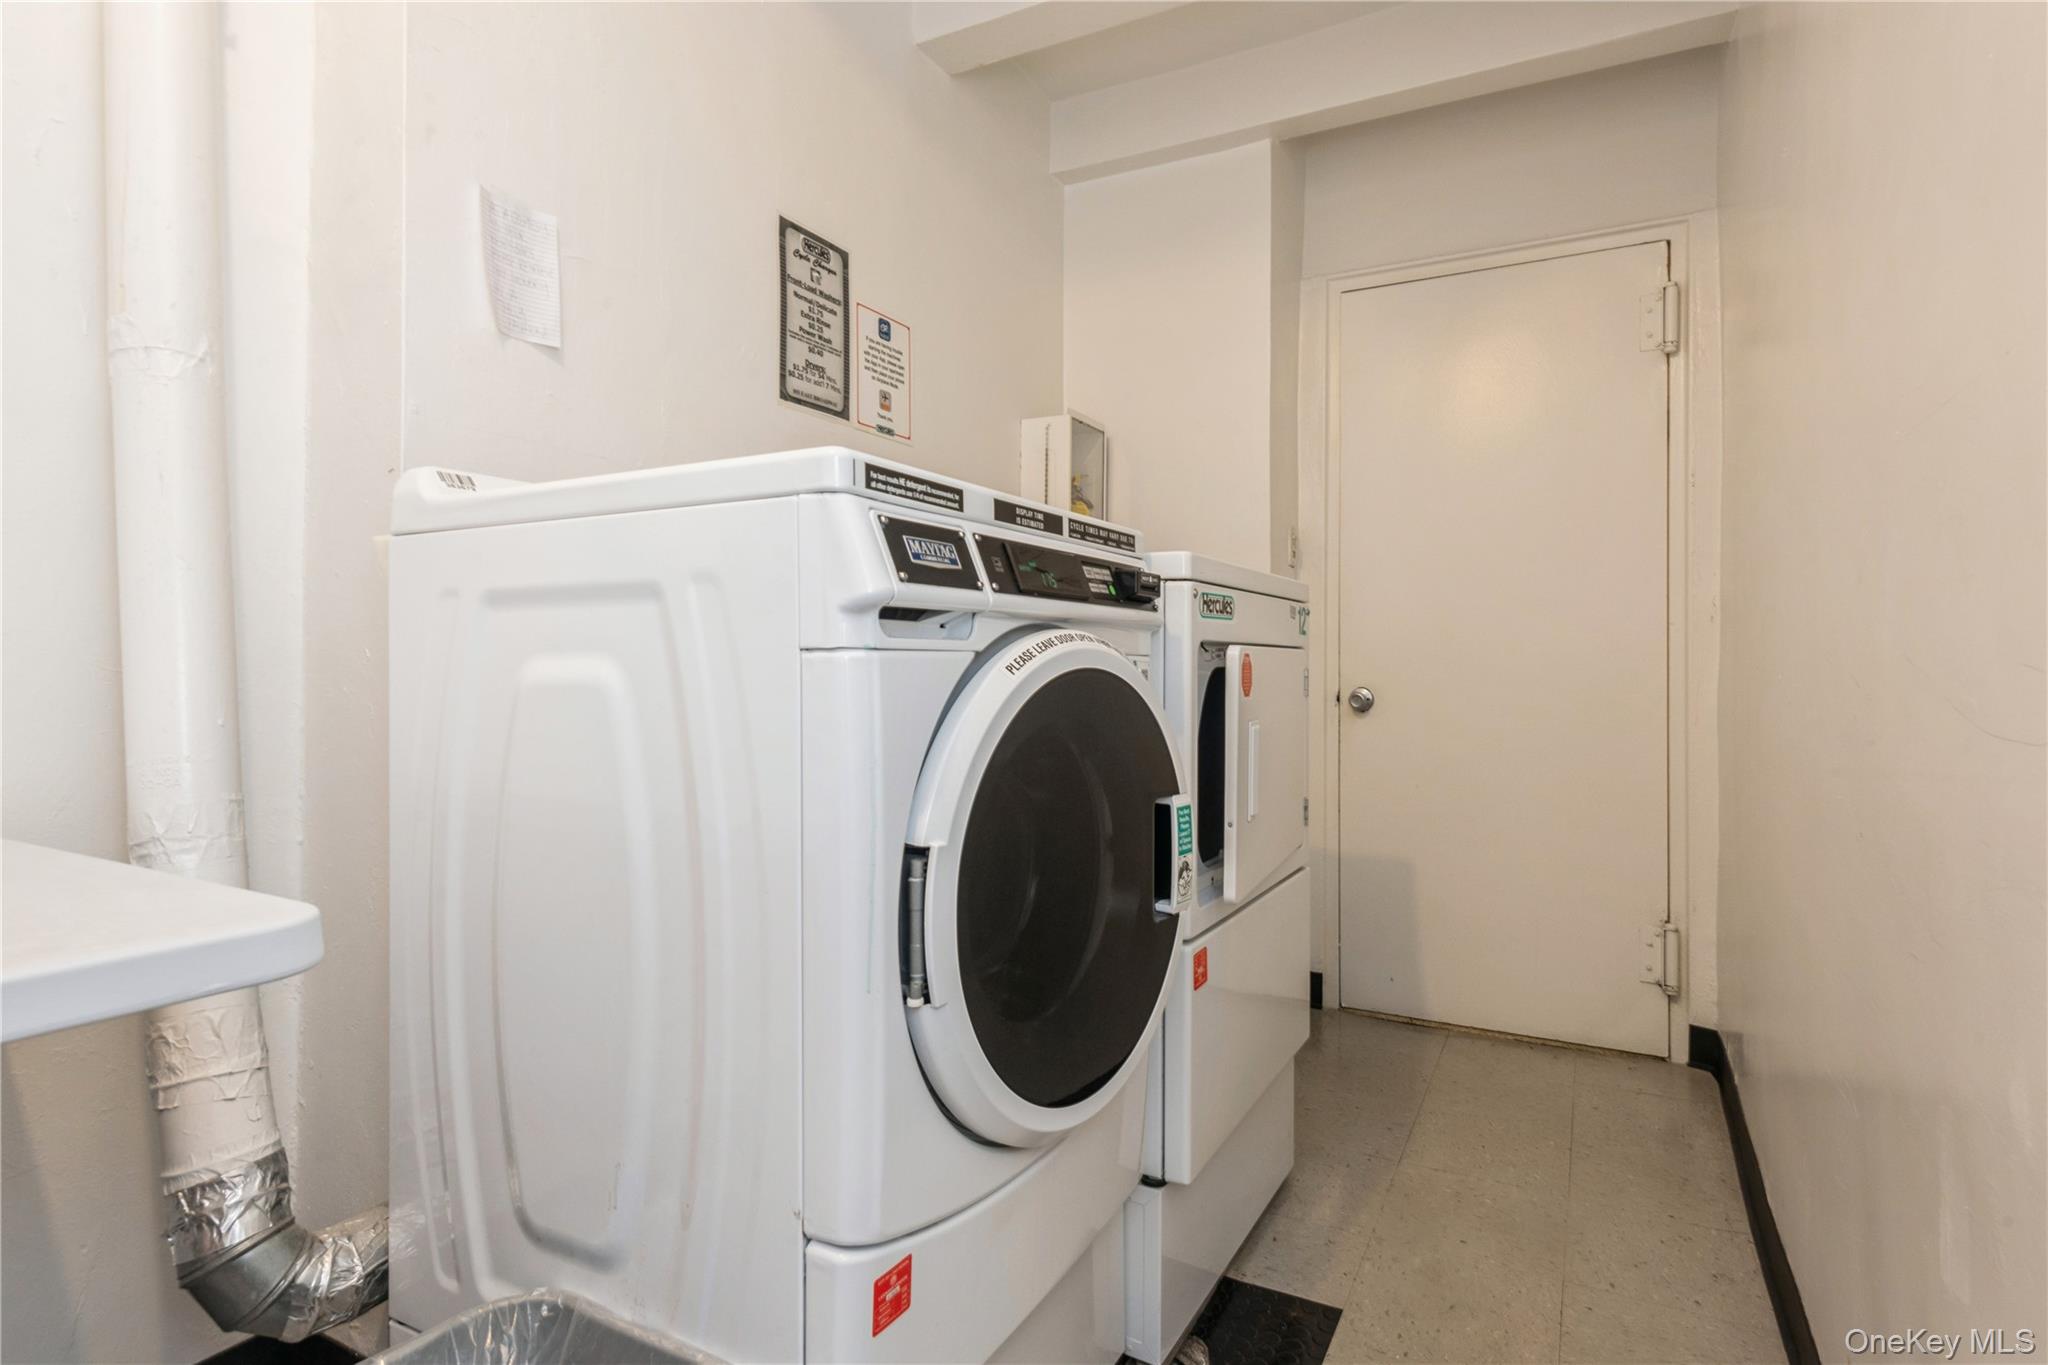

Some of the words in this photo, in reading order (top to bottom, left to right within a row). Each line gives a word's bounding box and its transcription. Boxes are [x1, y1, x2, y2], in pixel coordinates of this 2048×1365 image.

[801, 310, 815, 321] Extra
[816, 317, 831, 328] Rinse
[799, 326, 816, 338] Power
[1016, 507, 1033, 518] DISPLAY
[1034, 512, 1044, 521] TIME
[1016, 516, 1021, 524] IS
[1022, 518, 1044, 530] ESTIMATED
[1070, 521, 1084, 532] CYCLE
[1085, 526, 1098, 535] TIMES
[1100, 530, 1108, 538] MAY
[1109, 532, 1119, 541] VARY
[908, 539, 955, 559] MAYTAG
[1202, 593, 1233, 616] Hercules
[1005, 649, 1036, 676] PLEASE
[1033, 637, 1059, 658] LEAVE
[1054, 633, 1076, 645] DOOR
[1074, 633, 1095, 643] OPEN
